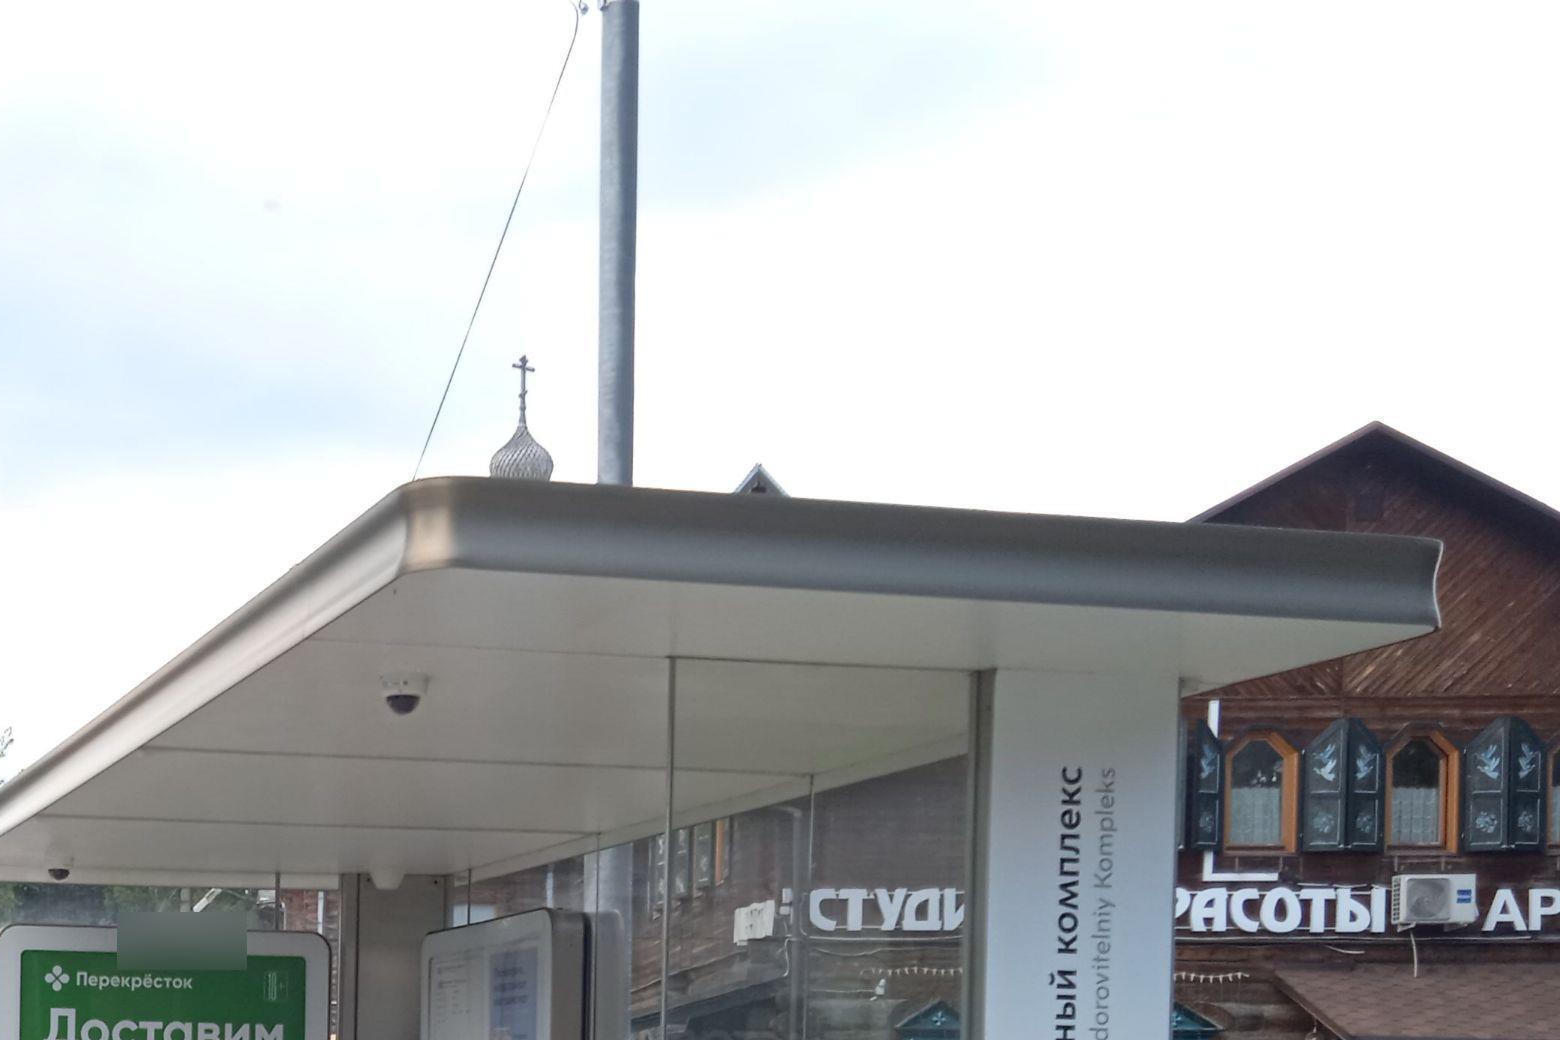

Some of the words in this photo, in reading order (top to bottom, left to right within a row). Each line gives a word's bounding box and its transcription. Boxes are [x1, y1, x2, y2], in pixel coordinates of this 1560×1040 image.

[1056, 766, 1083, 955] комплекс
[1093, 766, 1118, 889] Kompleks
[76, 971, 193, 991] Перекрёсток
